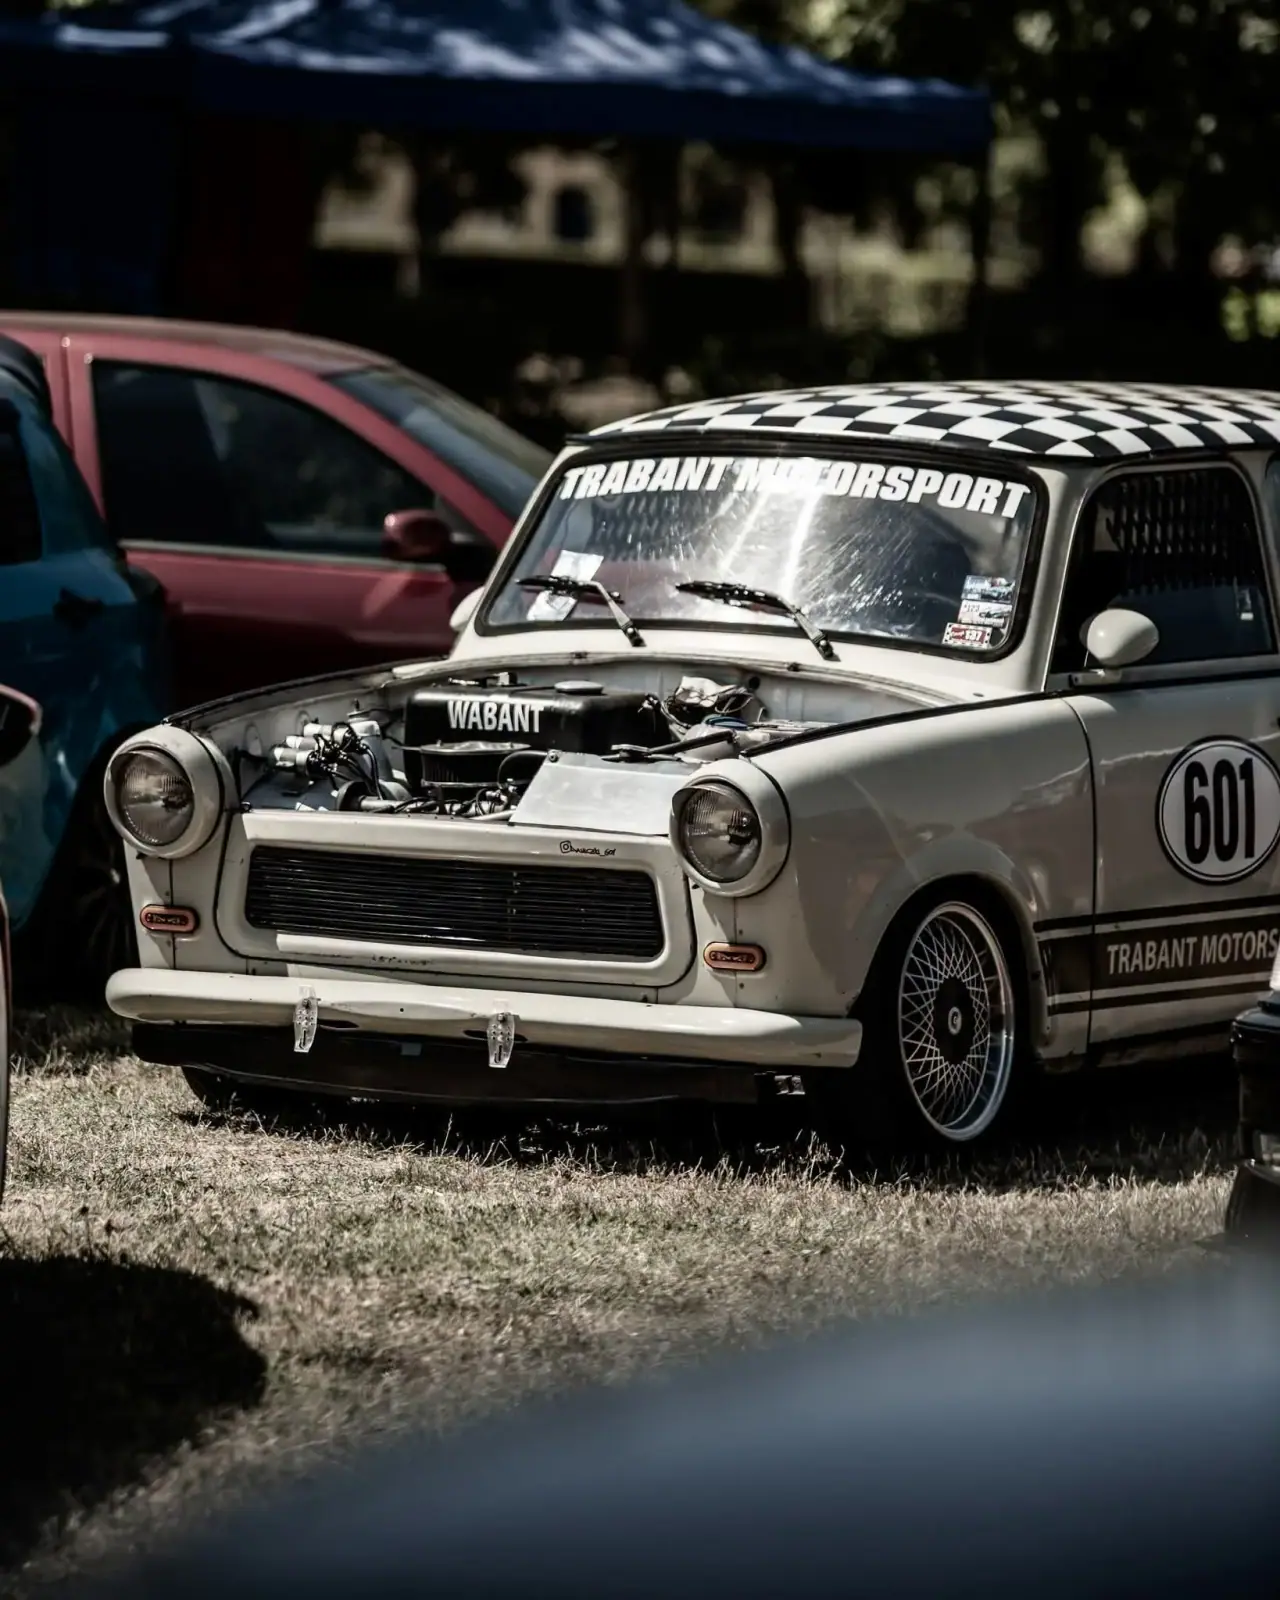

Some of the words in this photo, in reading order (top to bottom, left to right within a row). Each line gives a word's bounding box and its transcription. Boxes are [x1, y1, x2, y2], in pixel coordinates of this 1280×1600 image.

[560, 457, 734, 500] TRABANT
[733, 457, 1032, 519] MOTORSPORT
[447, 700, 544, 733] WABANT
[1184, 758, 1255, 864] 601
[1107, 936, 1198, 975] TRABANT
[1200, 928, 1280, 965] MOTORS
